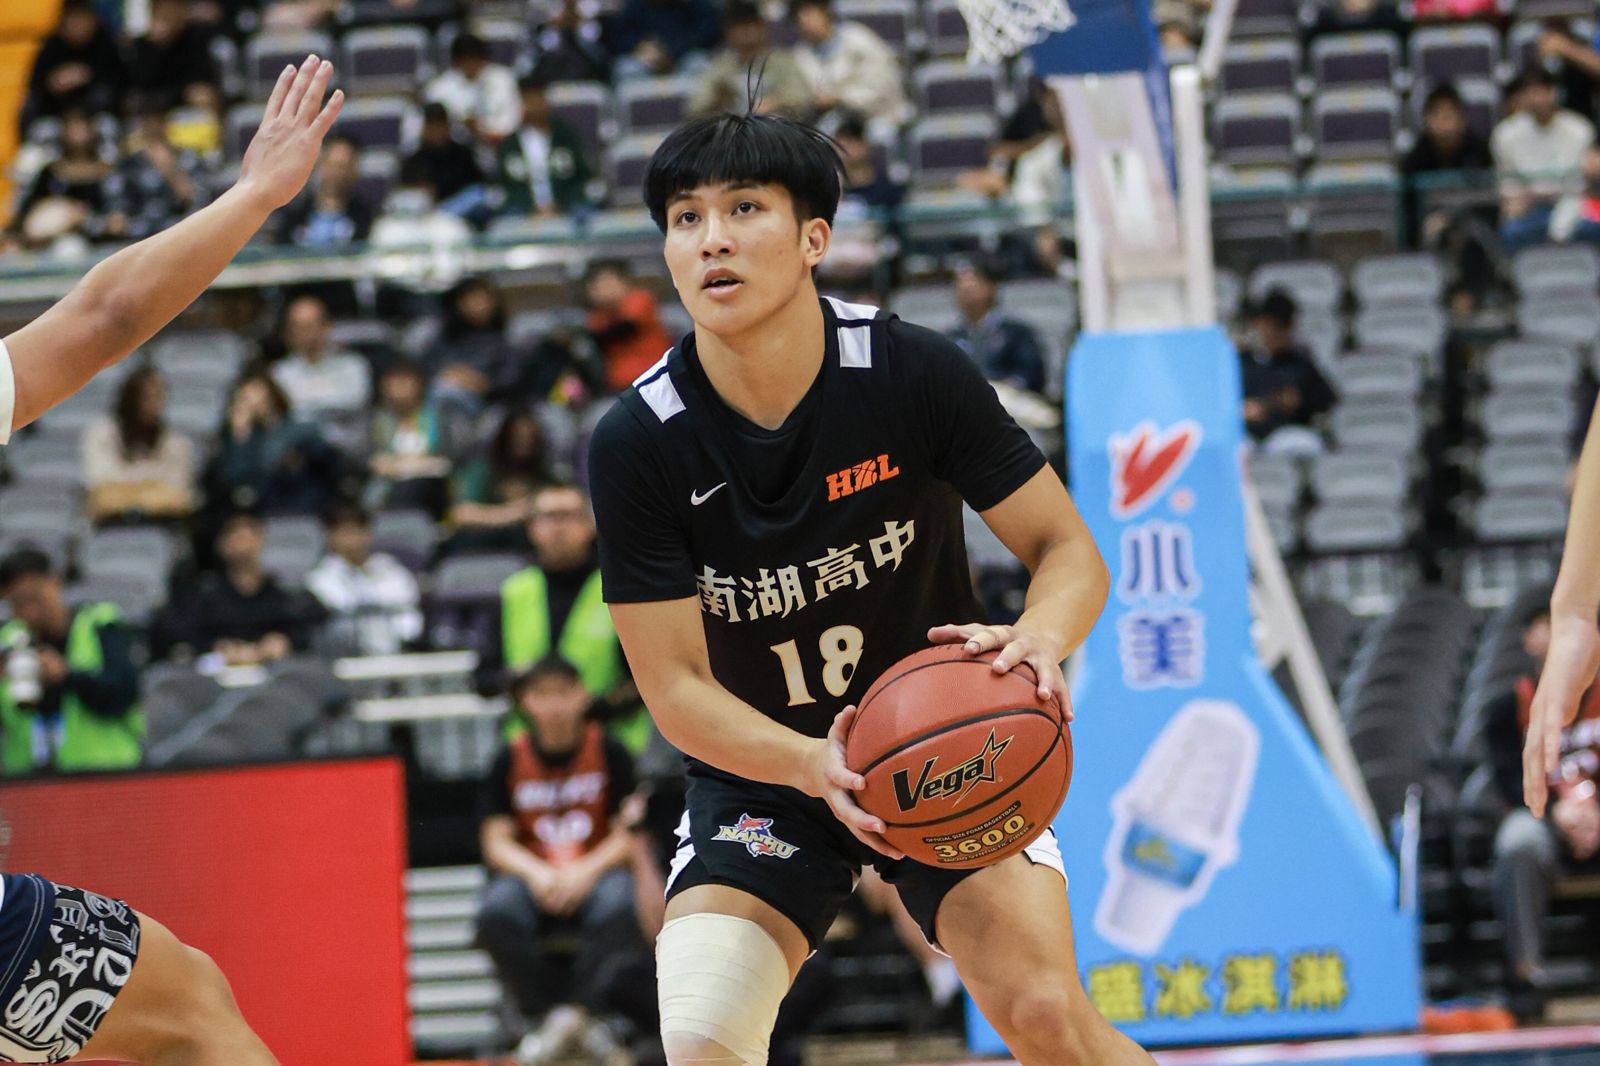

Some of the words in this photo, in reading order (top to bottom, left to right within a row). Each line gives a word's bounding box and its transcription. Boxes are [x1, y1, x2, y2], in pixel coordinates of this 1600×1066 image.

[826, 454, 899, 502] HBL
[695, 519, 915, 623] 南湖高中
[770, 624, 864, 707] 18
[892, 751, 988, 813] Vega
[720, 826, 795, 857] NANHU
[933, 814, 1025, 858] 3600
[951, 831, 966, 840] SIZE
[966, 825, 984, 836] FOAM
